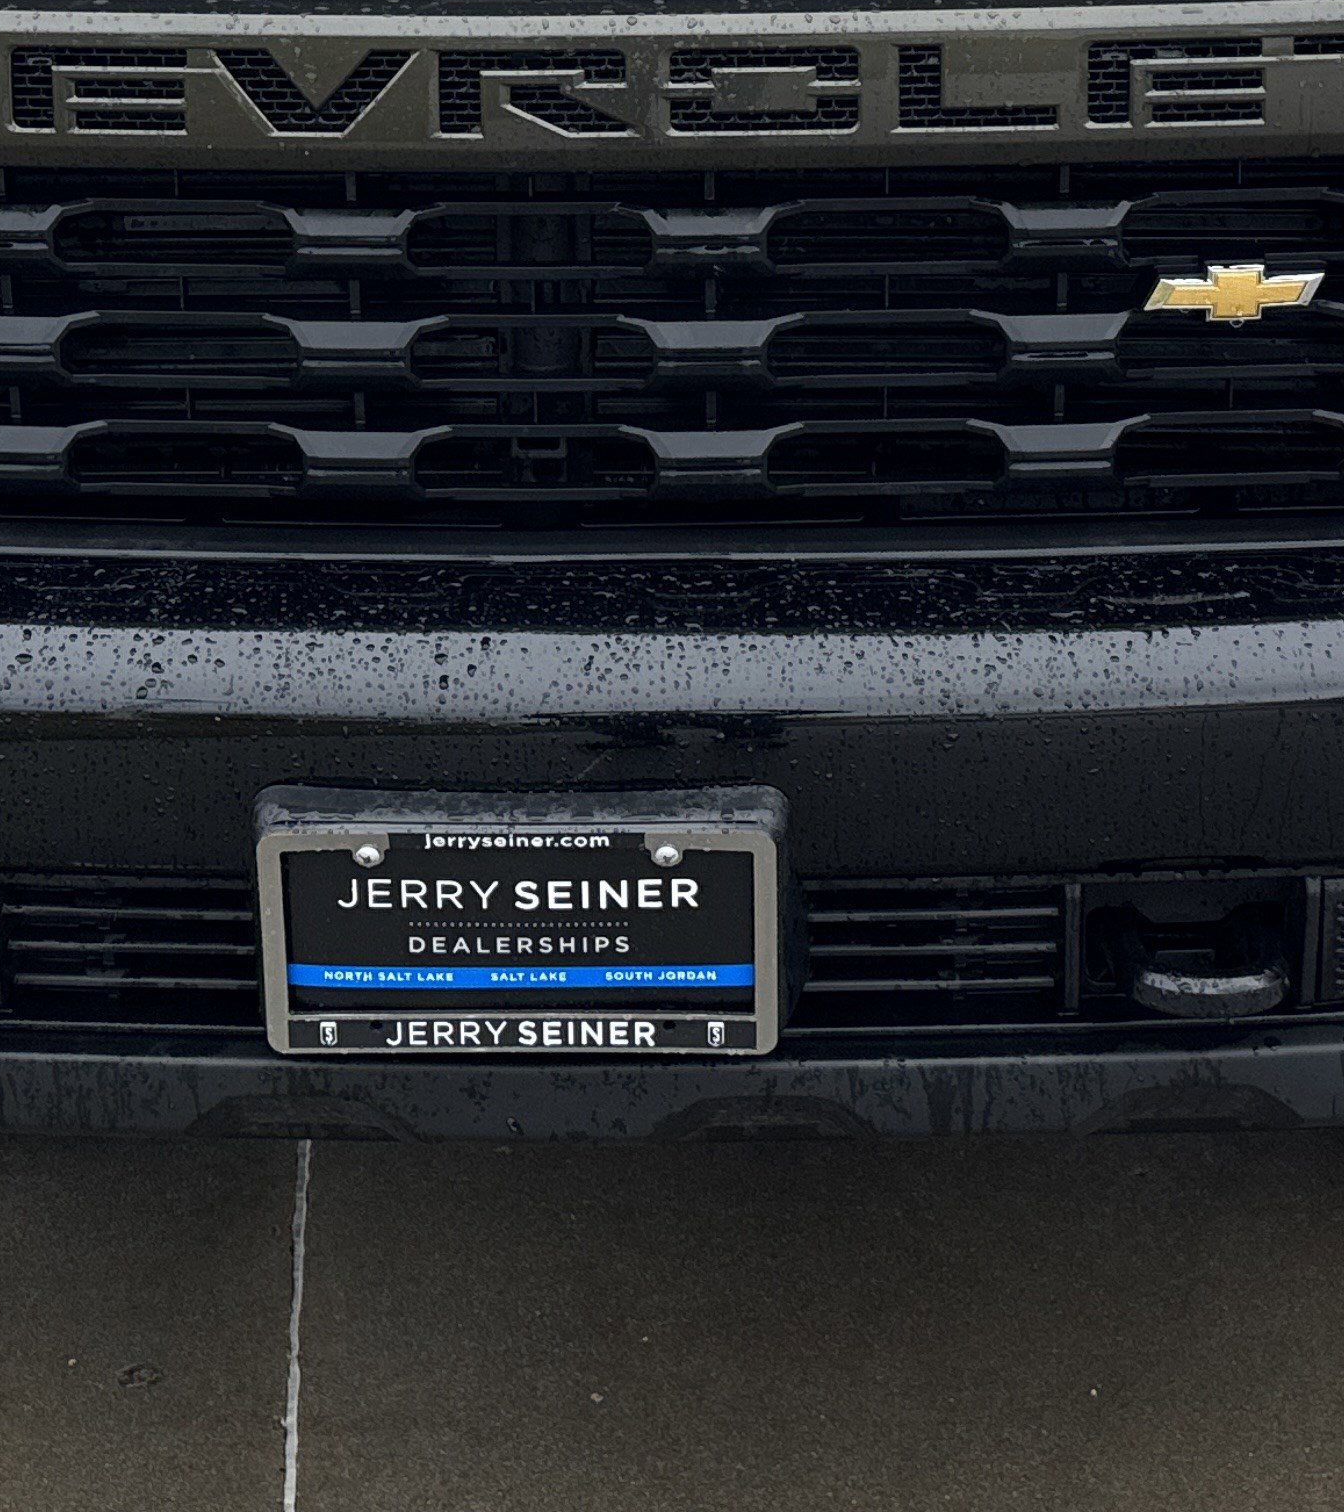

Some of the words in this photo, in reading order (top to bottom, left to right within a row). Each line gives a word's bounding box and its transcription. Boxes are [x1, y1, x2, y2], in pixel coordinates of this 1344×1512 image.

[423, 834, 610, 849] jerryseiner.com
[338, 879, 498, 908] JERRY
[514, 879, 699, 910] SEINER
[409, 936, 630, 954] DEALERSHIPS
[324, 970, 373, 981] NORTH
[378, 972, 411, 981] SALT
[417, 972, 454, 981] LAKE
[490, 972, 525, 981] SALT
[530, 972, 567, 981] LAKE
[605, 971, 653, 981] SOUTH
[657, 970, 717, 981] JORDAN
[386, 1021, 508, 1046] JERRY
[518, 1021, 656, 1046] SEINER
